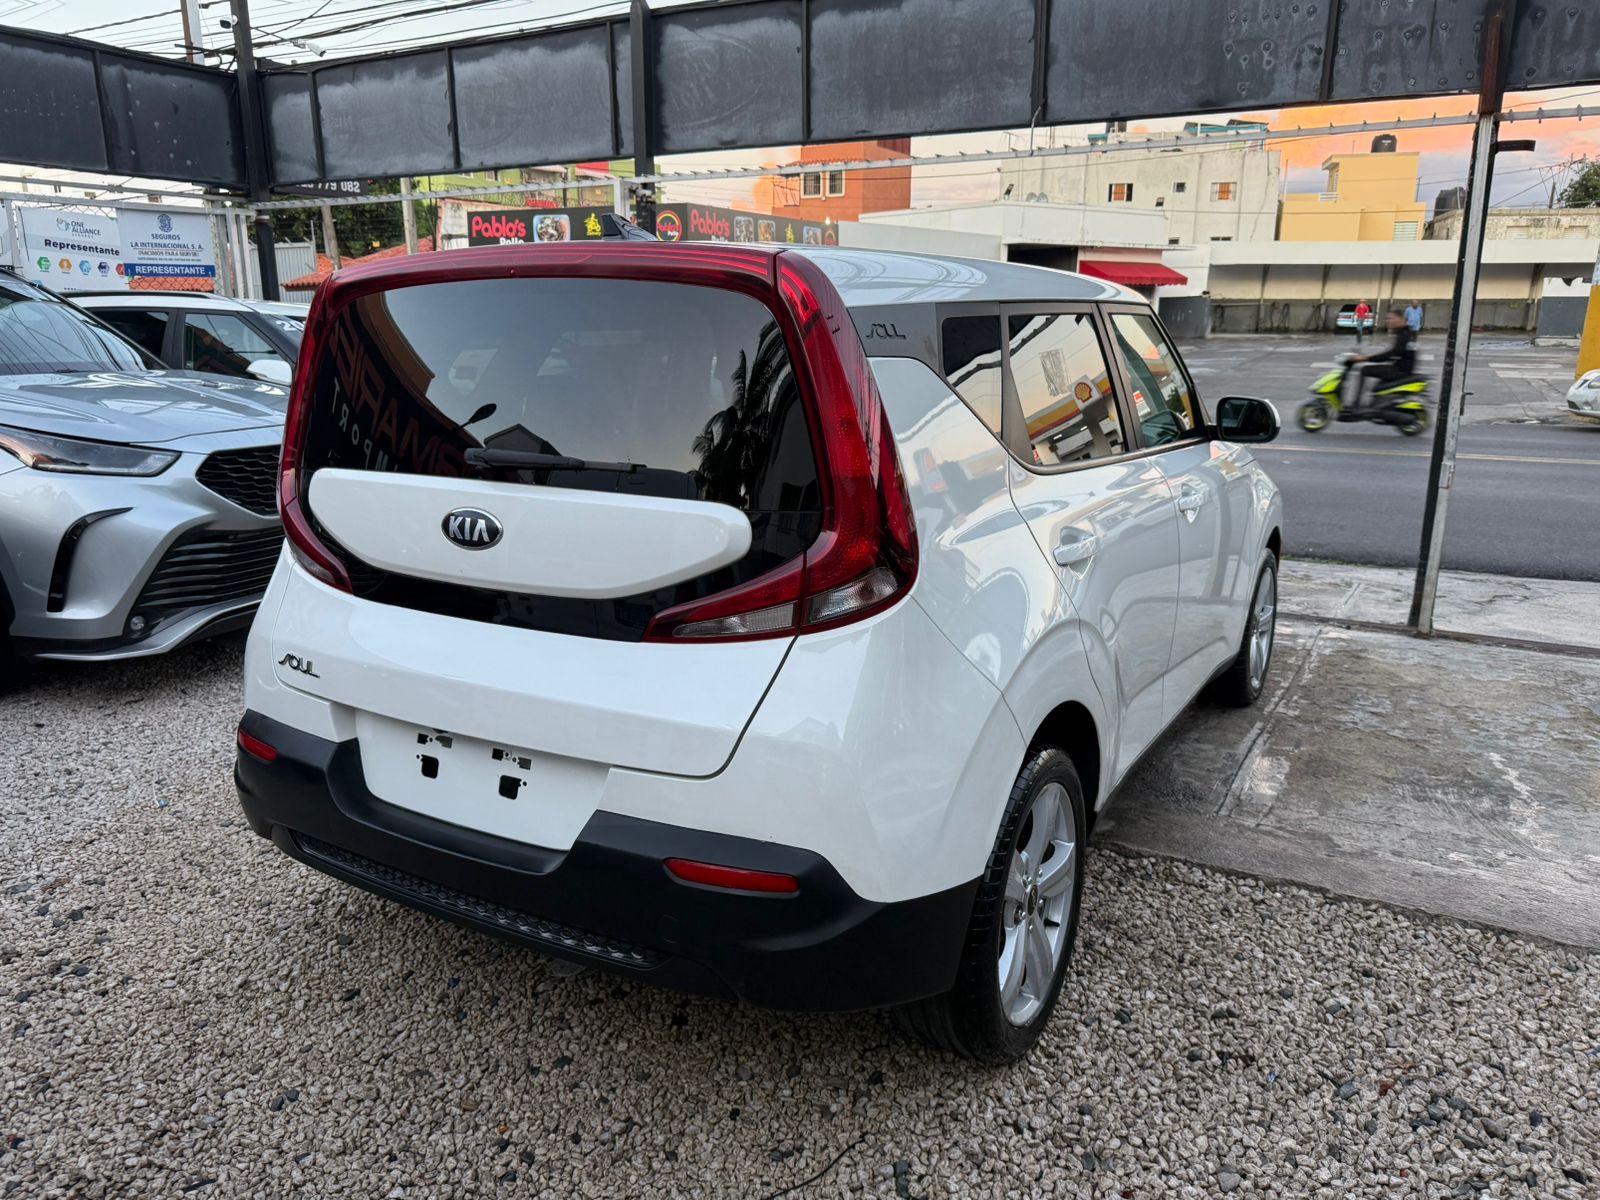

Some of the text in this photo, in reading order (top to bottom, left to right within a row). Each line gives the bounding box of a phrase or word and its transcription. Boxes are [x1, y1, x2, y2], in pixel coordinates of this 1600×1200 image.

[340, 181, 361, 193] 082
[71, 220, 85, 228] ONE
[471, 215, 527, 238] Pablo's
[691, 209, 731, 238] Pablo's
[71, 227, 101, 236] ALLIANCE
[151, 233, 181, 241] SEGUROS
[44, 238, 121, 257] Representante
[140, 242, 190, 250] INTERNACIONAL
[135, 265, 206, 275] REPRESENTANTE
[866, 323, 907, 340] SOUL
[449, 515, 491, 543] KIA
[278, 653, 321, 679] SOUL
